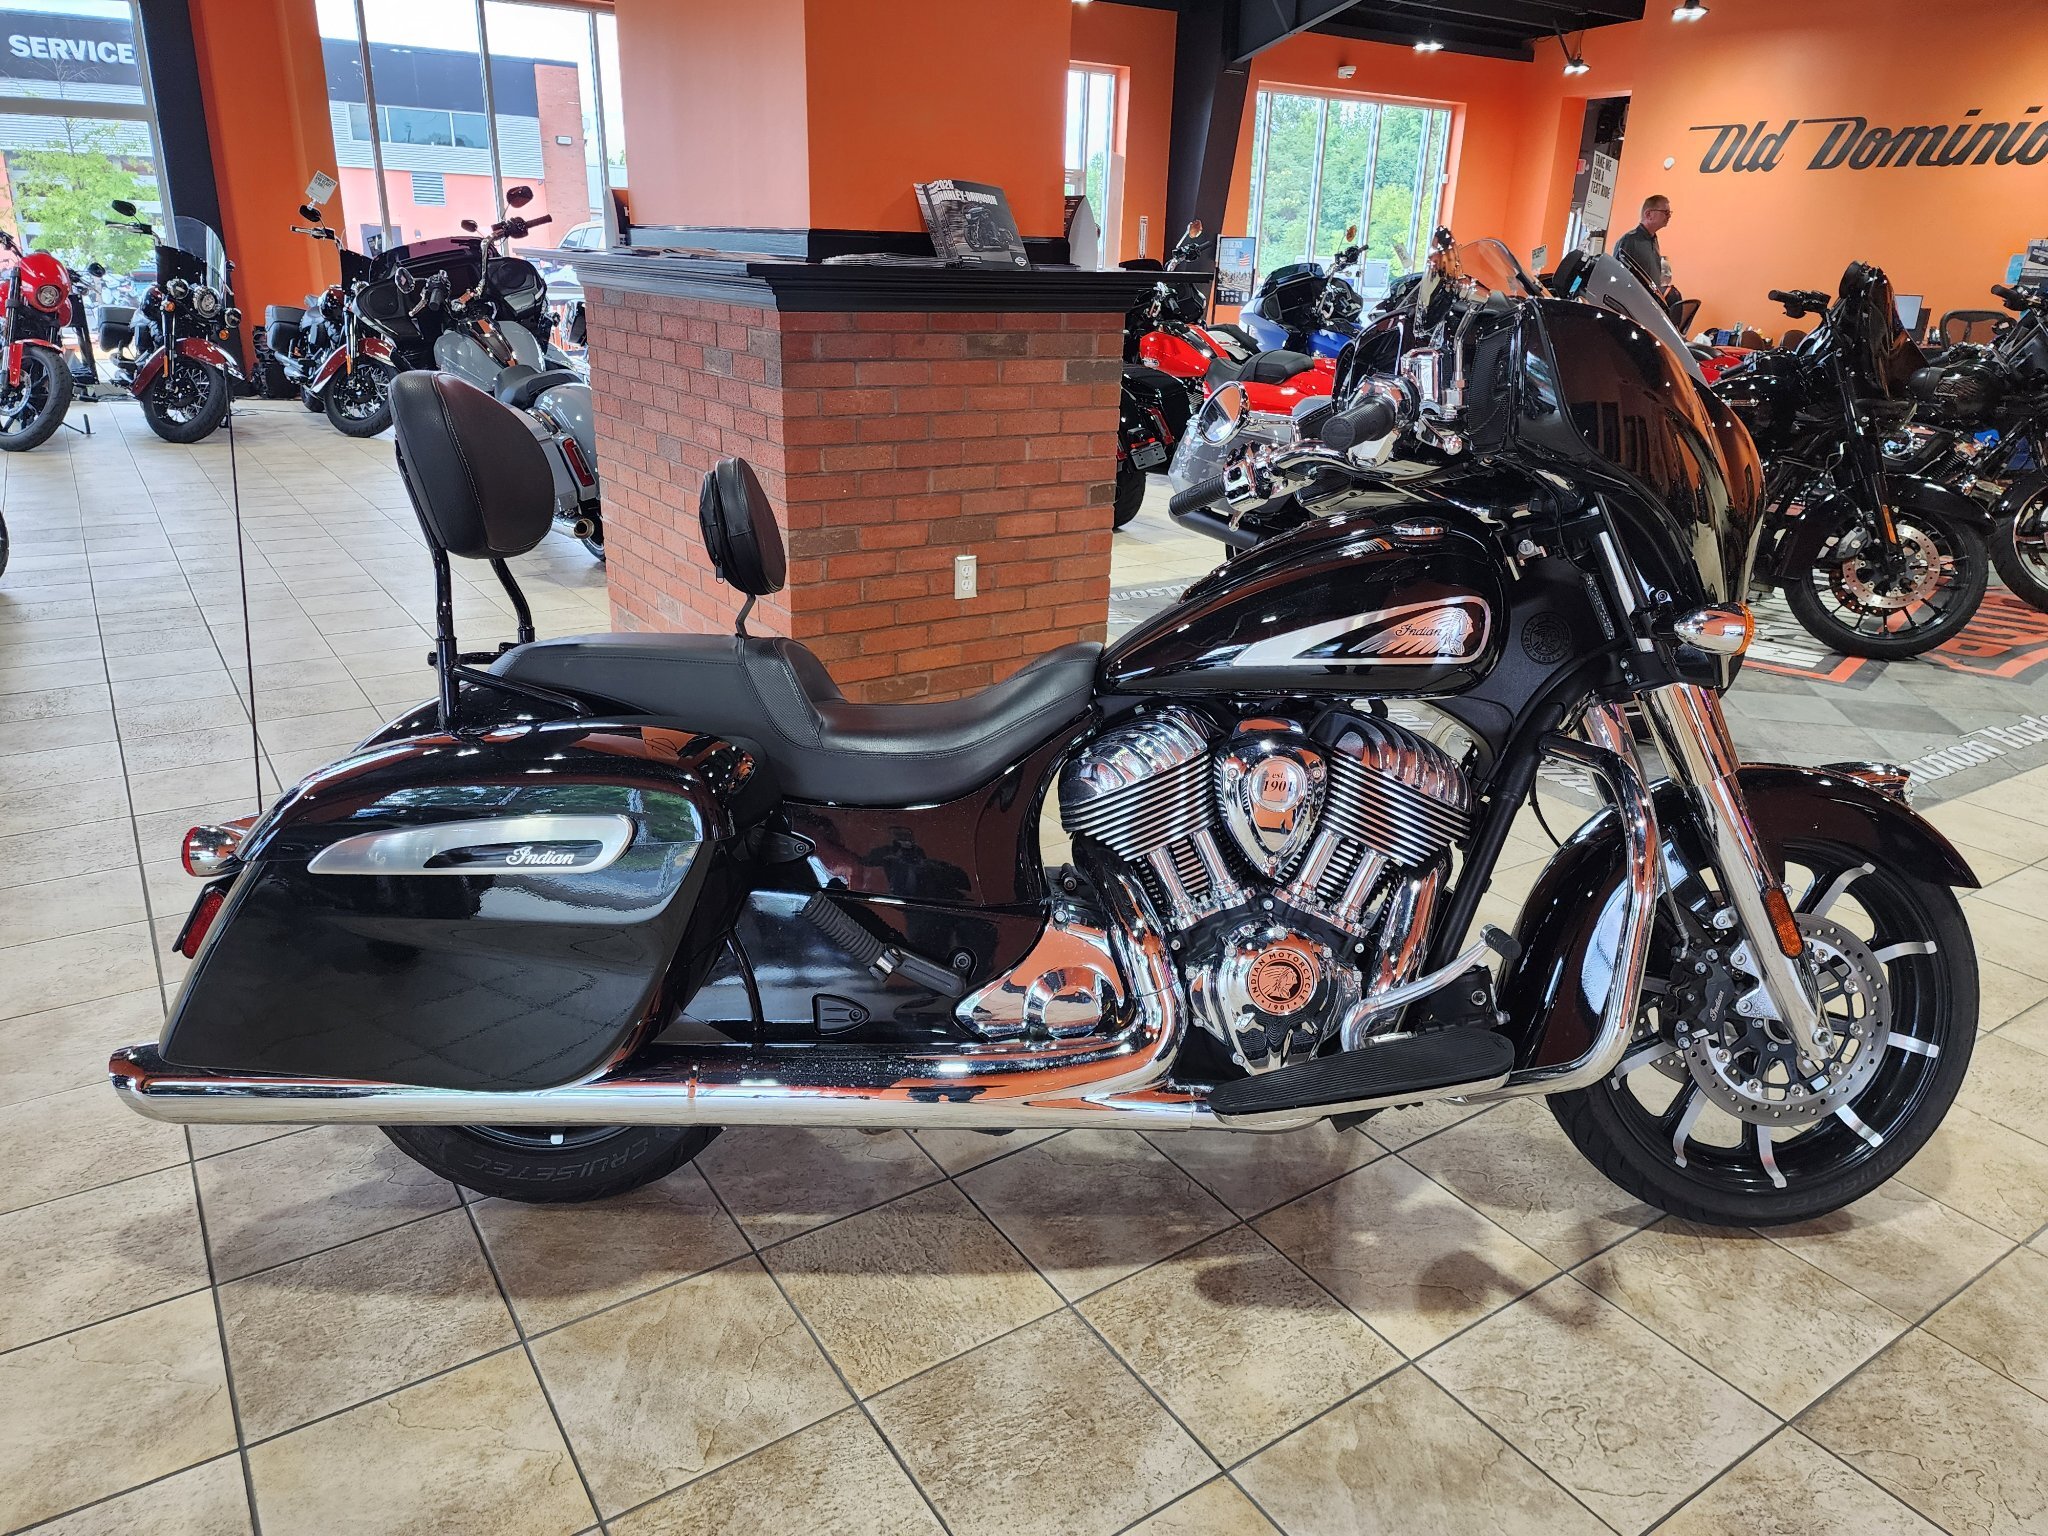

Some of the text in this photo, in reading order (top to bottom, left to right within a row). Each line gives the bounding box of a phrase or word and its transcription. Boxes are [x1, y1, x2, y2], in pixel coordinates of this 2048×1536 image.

[8, 34, 136, 65] SERVICE
[1689, 119, 1800, 173] Old
[1591, 181, 1602, 195] TEST
[1395, 623, 1443, 637] Indian
[1263, 780, 1293, 792] 1901
[505, 846, 575, 866] Indian
[1250, 952, 1312, 1001] INDIAN MOTORCYCLE
[1267, 1002, 1292, 1011] 1901
[1709, 990, 1725, 1022] Indian
